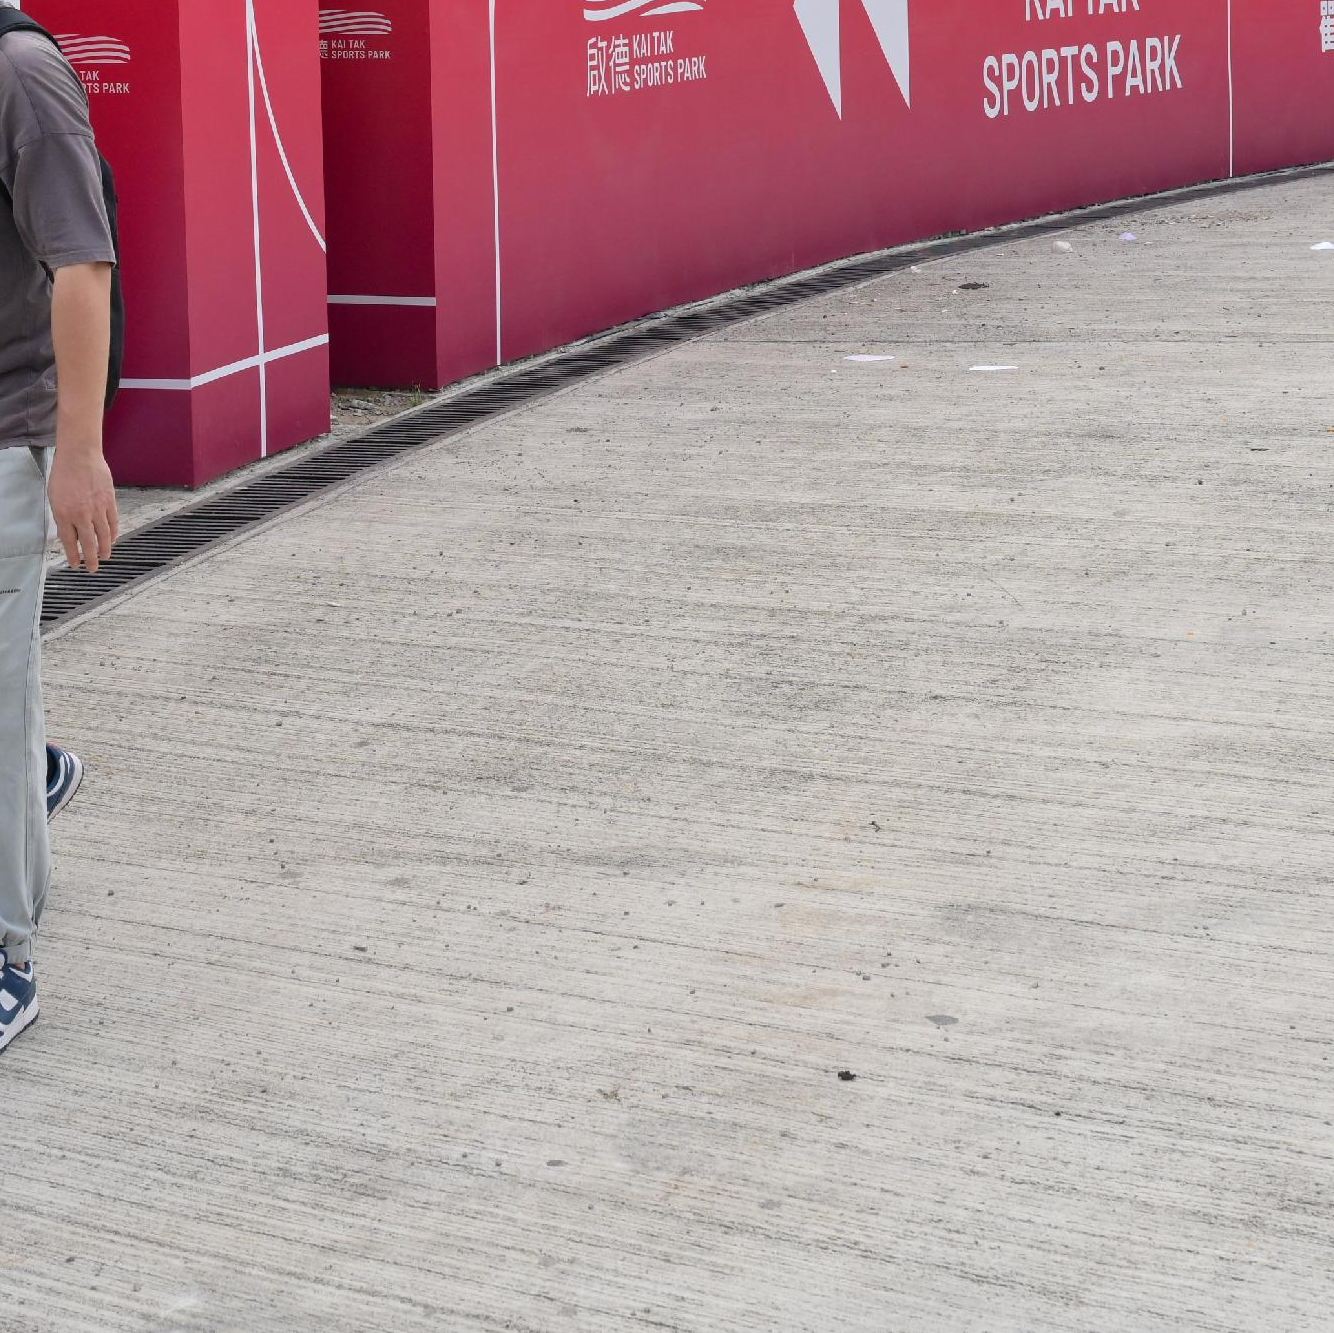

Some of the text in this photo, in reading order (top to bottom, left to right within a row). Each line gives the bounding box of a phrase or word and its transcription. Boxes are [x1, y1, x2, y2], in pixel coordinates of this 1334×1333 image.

[331, 39, 366, 49] KAI TAK
[632, 30, 674, 59] KAI TAK
[331, 50, 391, 59] SPORTS PARK
[79, 70, 100, 81] TAK
[586, 33, 630, 98] 啟德
[634, 55, 707, 90] SPORTS PARK
[983, 34, 1183, 119] SPORTS PARK
[102, 82, 130, 94] PARK
